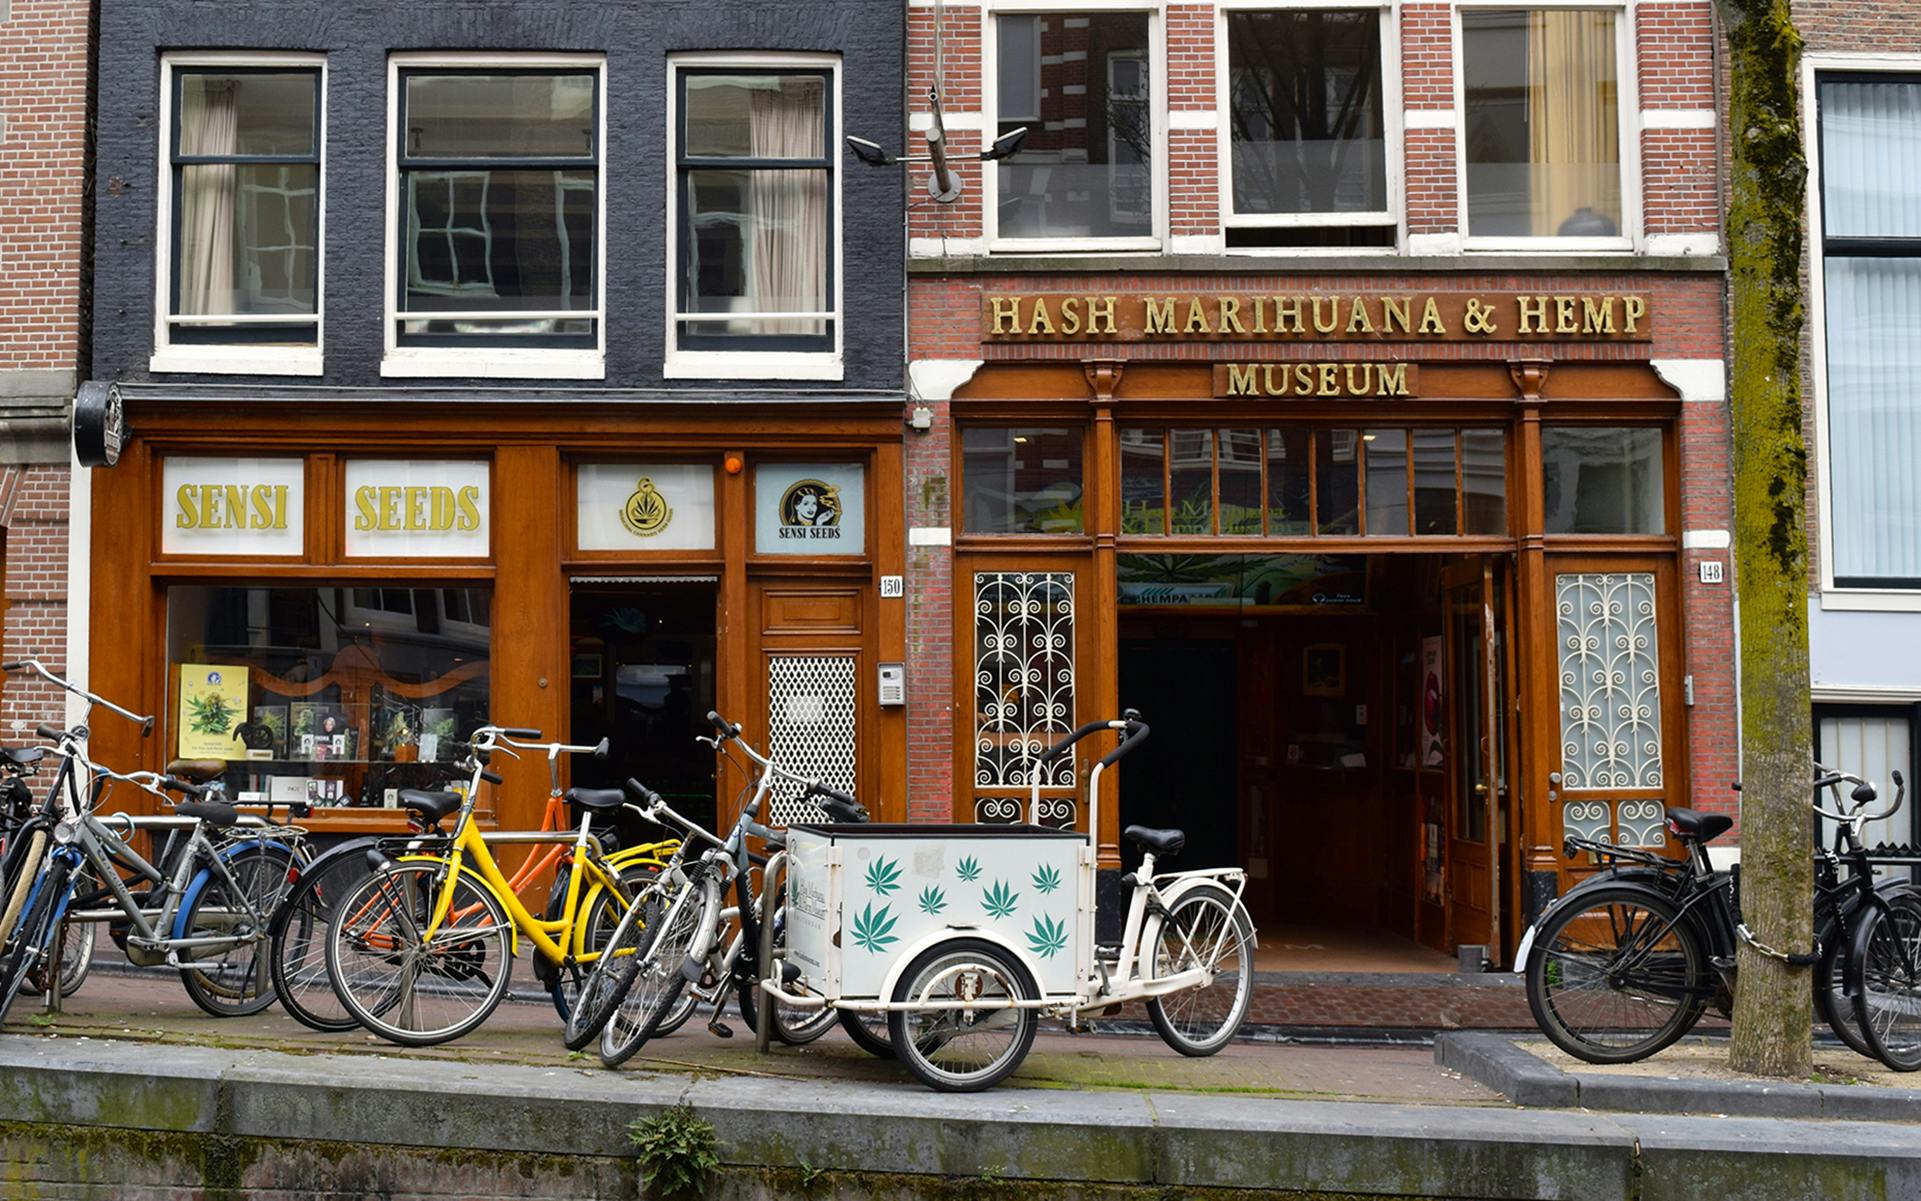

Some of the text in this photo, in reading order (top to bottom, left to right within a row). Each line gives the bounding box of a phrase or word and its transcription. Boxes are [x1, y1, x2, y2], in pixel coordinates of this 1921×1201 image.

[990, 296, 1646, 335] HASH MARIHUANA & HEMP
[1227, 363, 1409, 397] MUSEUM
[176, 484, 480, 531] SENSI SEEDS
[778, 527, 840, 539] SENSI SEEDS
[1702, 564, 1720, 581] 148
[883, 579, 901, 595] 150
